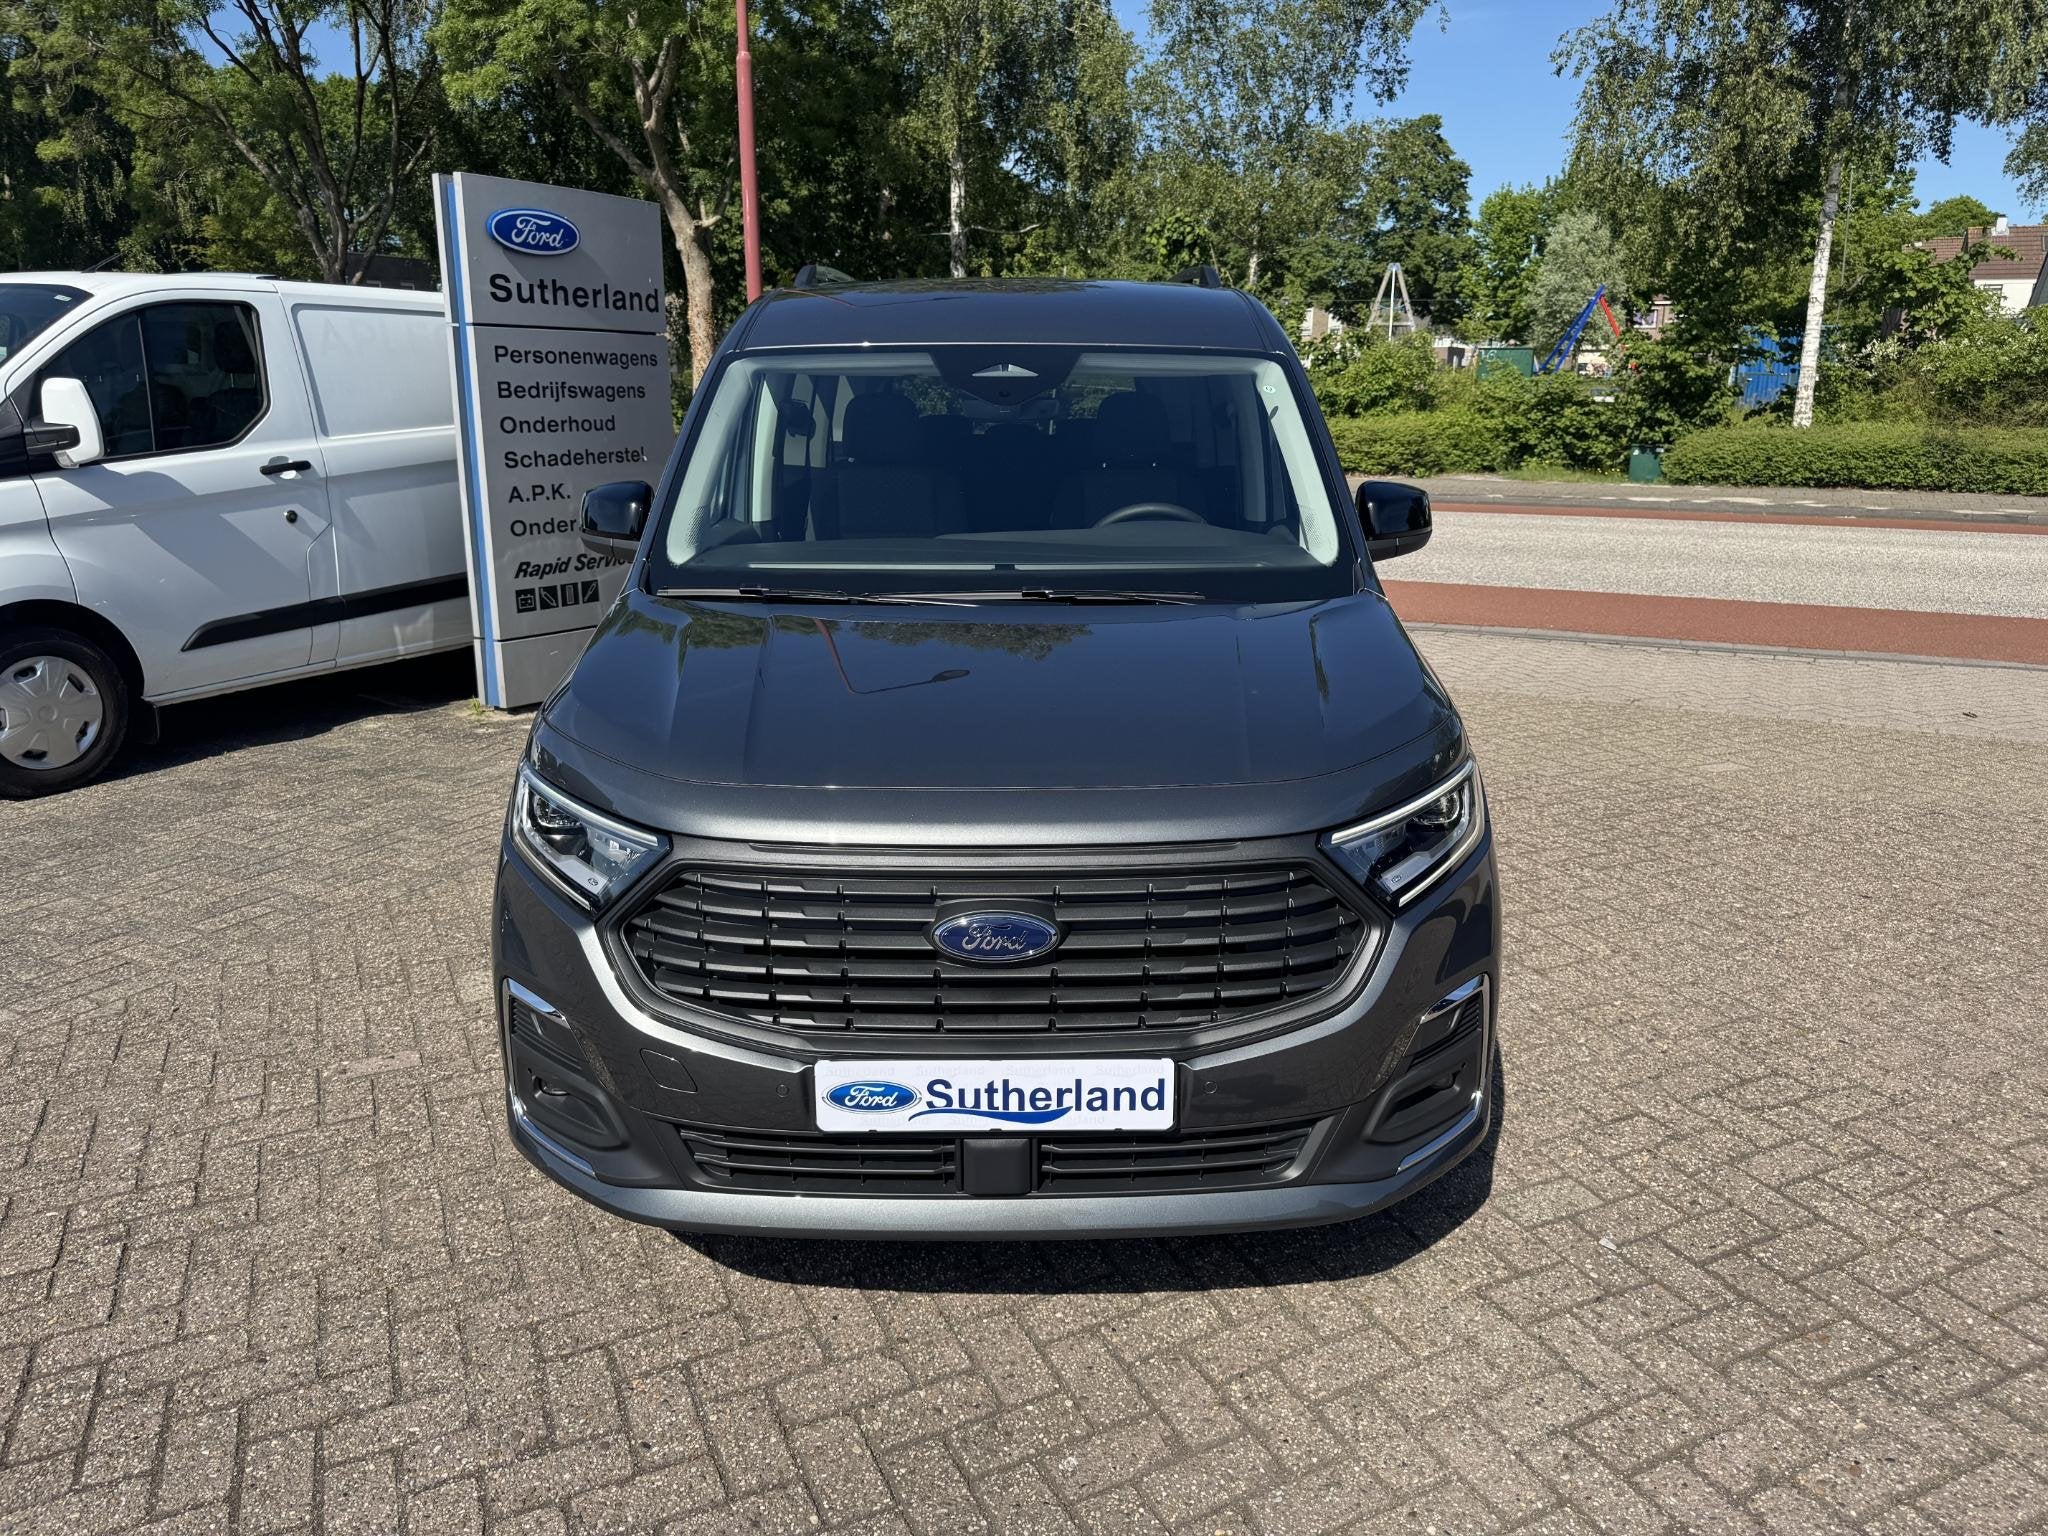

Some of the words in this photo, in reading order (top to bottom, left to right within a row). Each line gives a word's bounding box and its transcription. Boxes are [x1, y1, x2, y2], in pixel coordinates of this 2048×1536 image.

[511, 216, 564, 247] Ford
[489, 273, 659, 313] Sutherland
[494, 345, 658, 370] Personenwagens
[497, 381, 646, 402] Bedrijfswagens
[500, 415, 616, 434] Onderhoud
[504, 446, 645, 469] Schadeherstel
[508, 483, 571, 503] A.P.K.
[510, 517, 578, 537] Onder
[514, 556, 573, 580] Rapid
[574, 553, 634, 571] Servi
[961, 923, 1029, 951] Ford
[844, 1085, 899, 1107] Ford
[926, 1078, 1166, 1112] Sutherland
